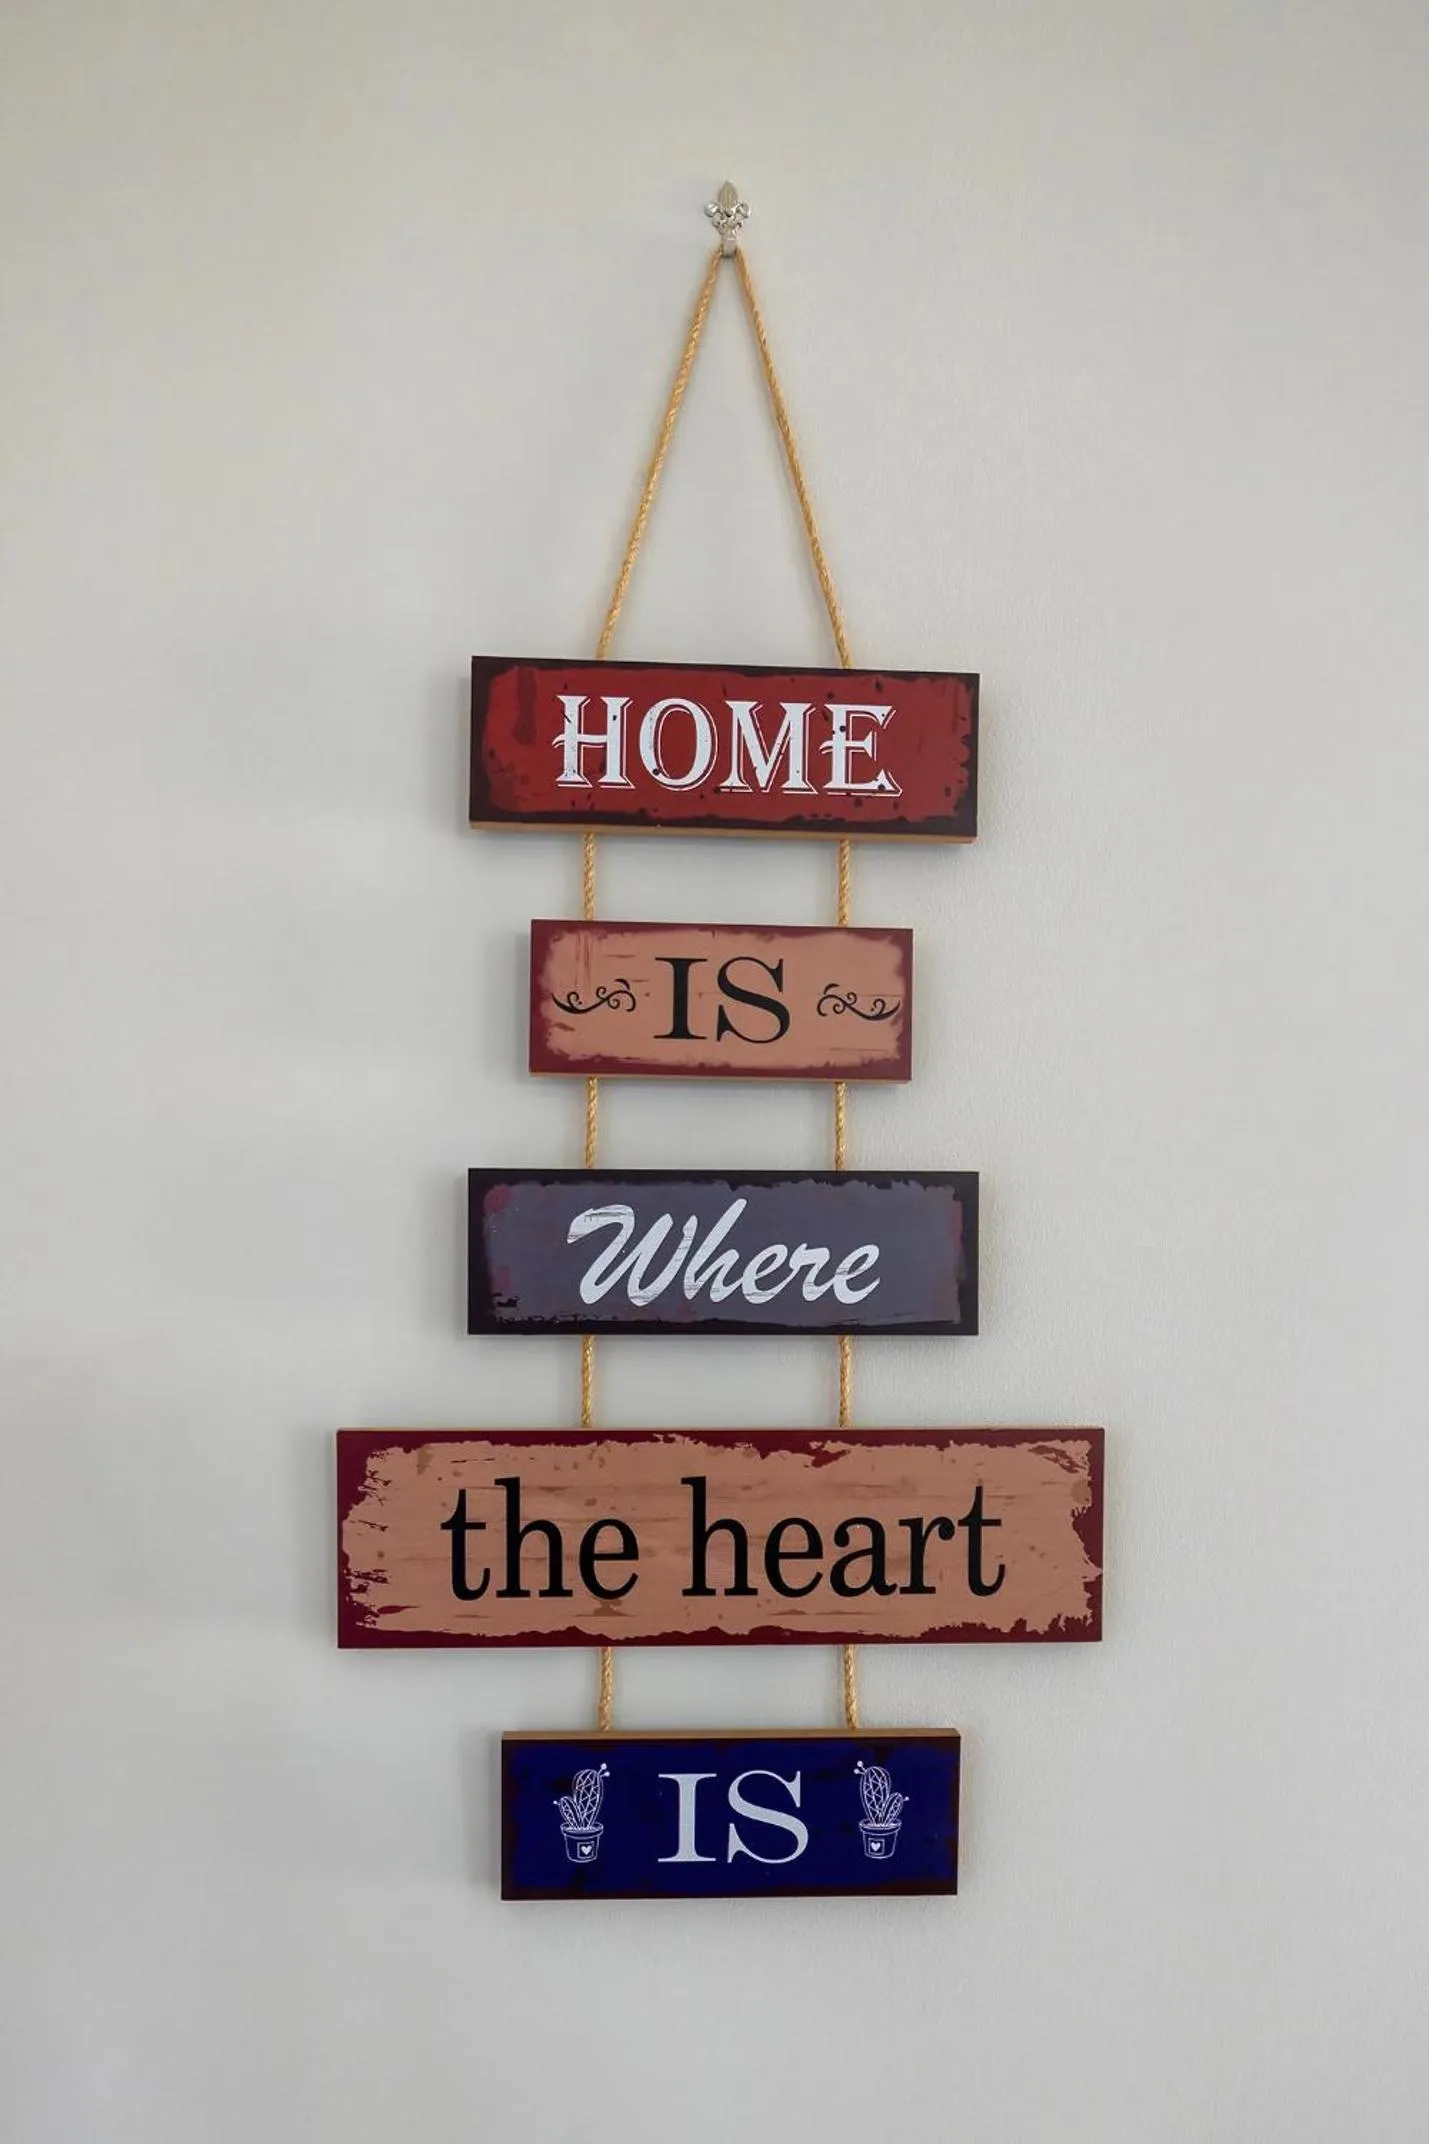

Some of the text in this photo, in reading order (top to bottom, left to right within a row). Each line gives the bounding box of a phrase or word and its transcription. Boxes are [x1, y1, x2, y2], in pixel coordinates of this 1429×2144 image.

[551, 694, 903, 798] HOME
[653, 956, 792, 1045] IS
[566, 1198, 881, 1307] Where
[440, 1475, 1006, 1601] the heart
[657, 1769, 809, 1864] IS
